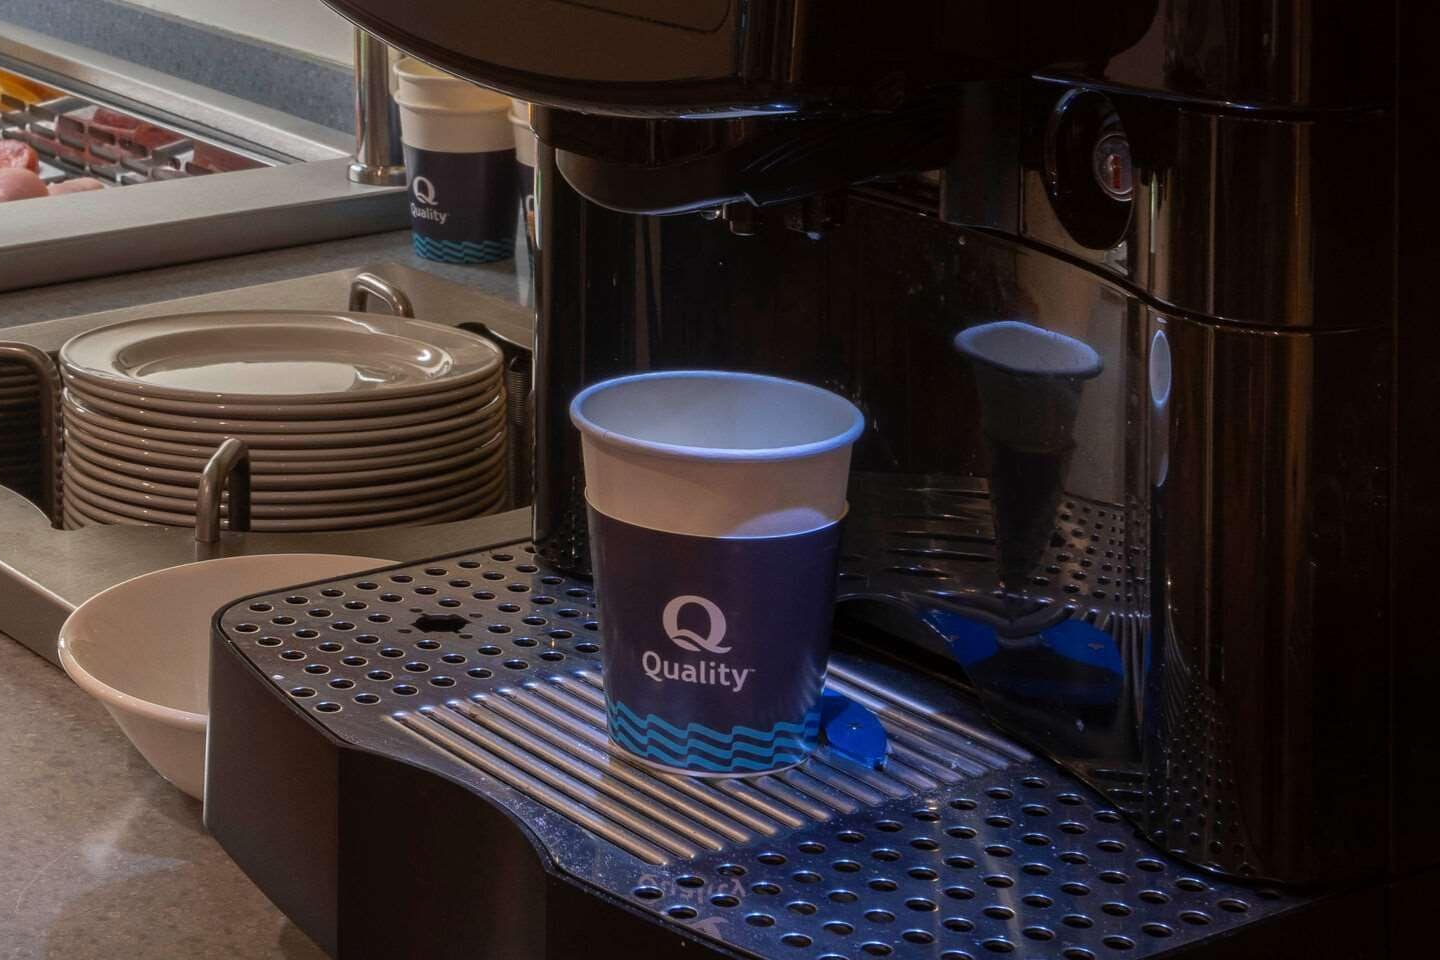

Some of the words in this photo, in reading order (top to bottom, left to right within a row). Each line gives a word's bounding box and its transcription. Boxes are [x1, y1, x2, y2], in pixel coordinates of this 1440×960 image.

[413, 176, 439, 205] Q
[410, 201, 448, 225] Quality
[662, 594, 733, 654] Q
[642, 650, 749, 692] Quality
